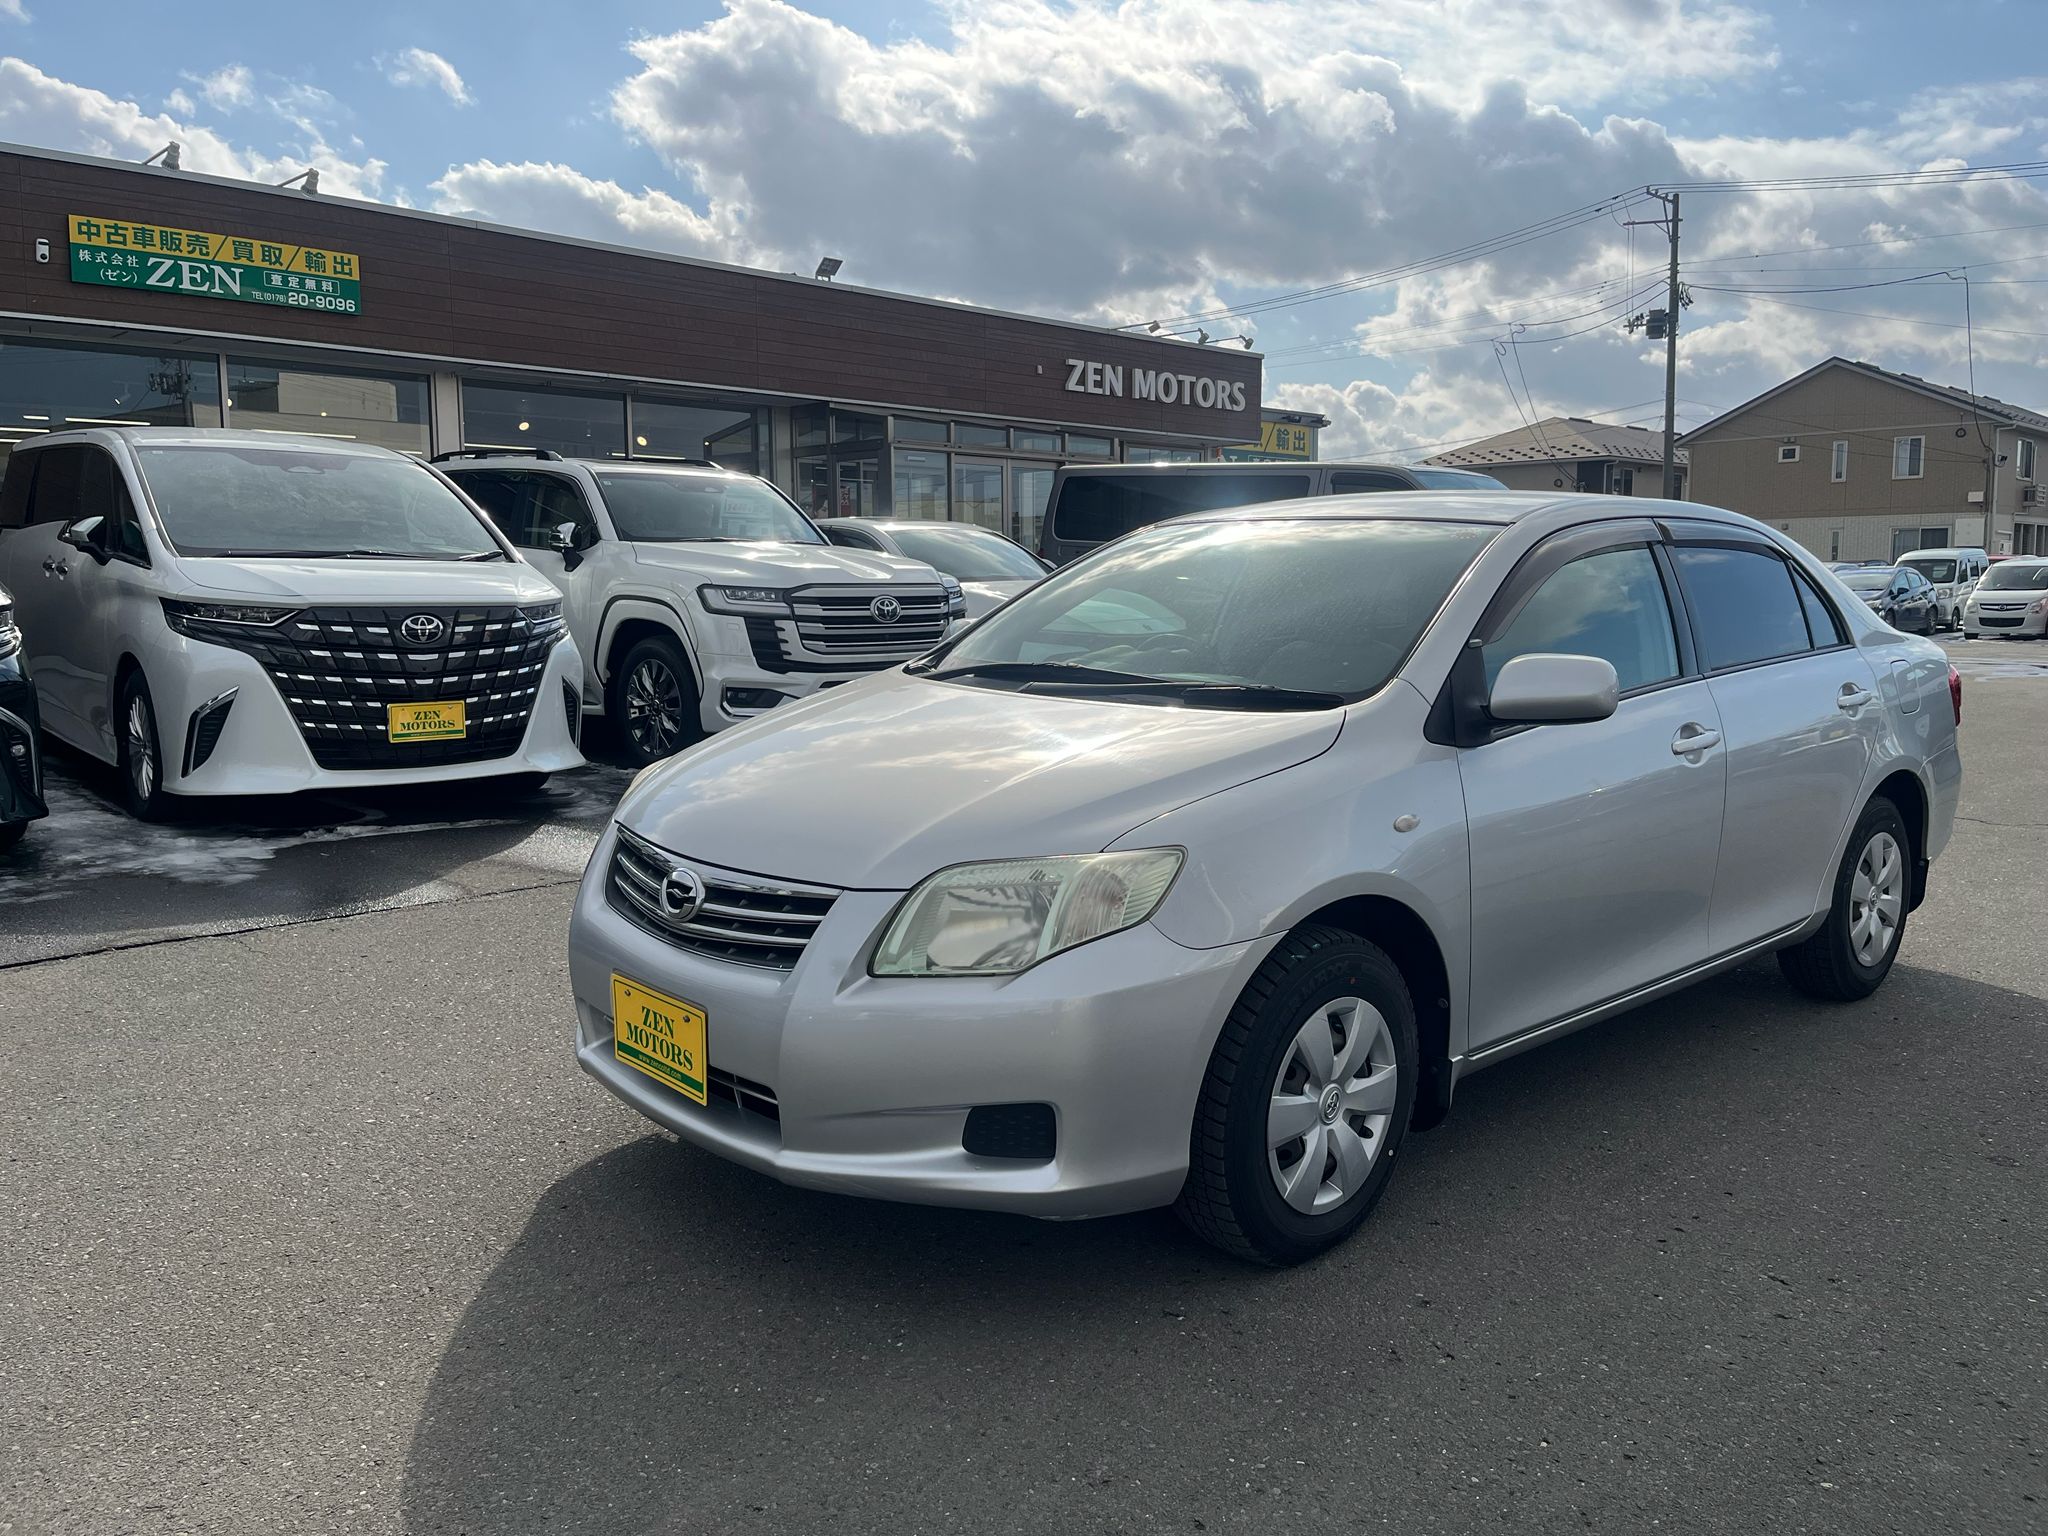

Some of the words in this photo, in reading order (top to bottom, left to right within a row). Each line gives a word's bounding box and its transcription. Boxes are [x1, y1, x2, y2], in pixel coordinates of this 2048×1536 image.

[79, 249, 139, 268] 株式会社
[145, 256, 244, 296] ZEN
[270, 274, 333, 293] 査定無料
[1065, 358, 1123, 397] ZEN
[1132, 368, 1246, 412] MOTORS
[400, 719, 456, 731] MOTORS
[413, 710, 441, 720] ZEN
[641, 1005, 675, 1039] ZEN
[625, 1021, 694, 1071] MOTORS
